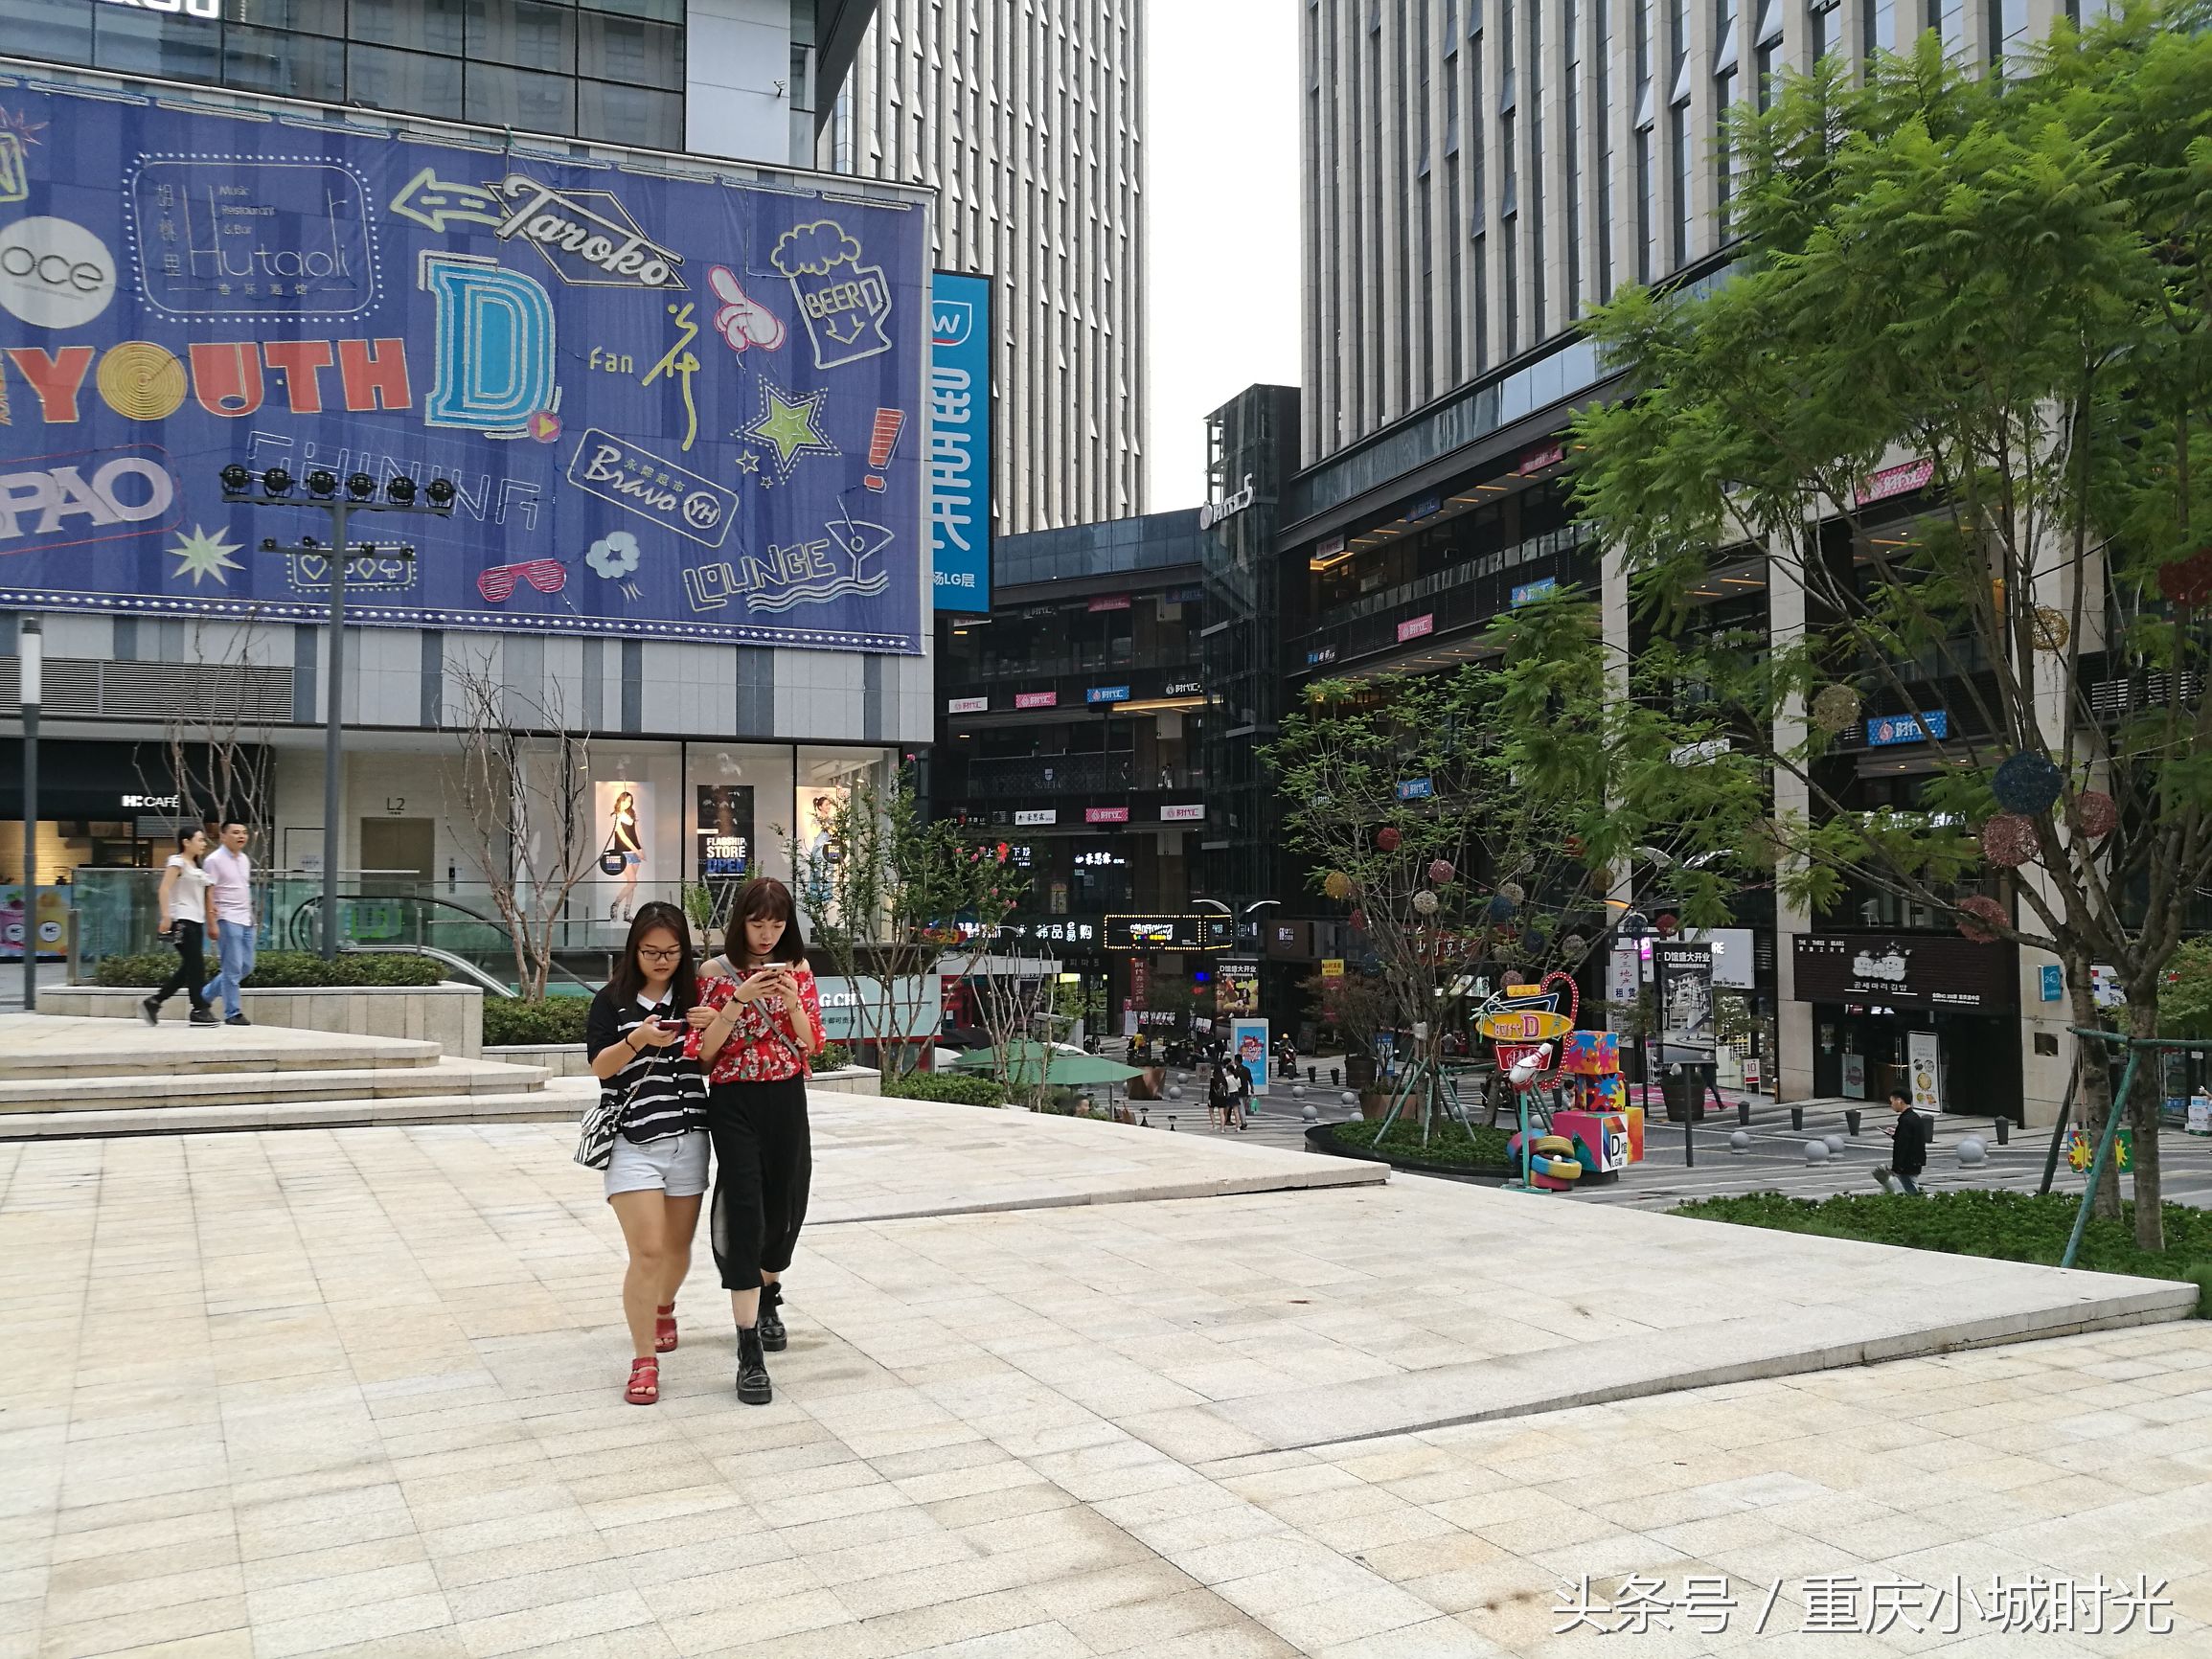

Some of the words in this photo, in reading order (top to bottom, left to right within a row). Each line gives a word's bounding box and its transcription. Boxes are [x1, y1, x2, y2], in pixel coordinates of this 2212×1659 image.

[218, 185, 249, 196] Music
[182, 185, 351, 277] Hutaoli
[494, 173, 671, 286] Taroko
[582, 443, 677, 511] Bravo
[690, 498, 718, 524] YH
[683, 538, 836, 611] LOUNGE
[386, 797, 405, 811] L2
[706, 837, 746, 846] FLAGSHIP
[706, 846, 746, 858] STORE
[1664, 951, 1710, 963] D馆盛大开业
